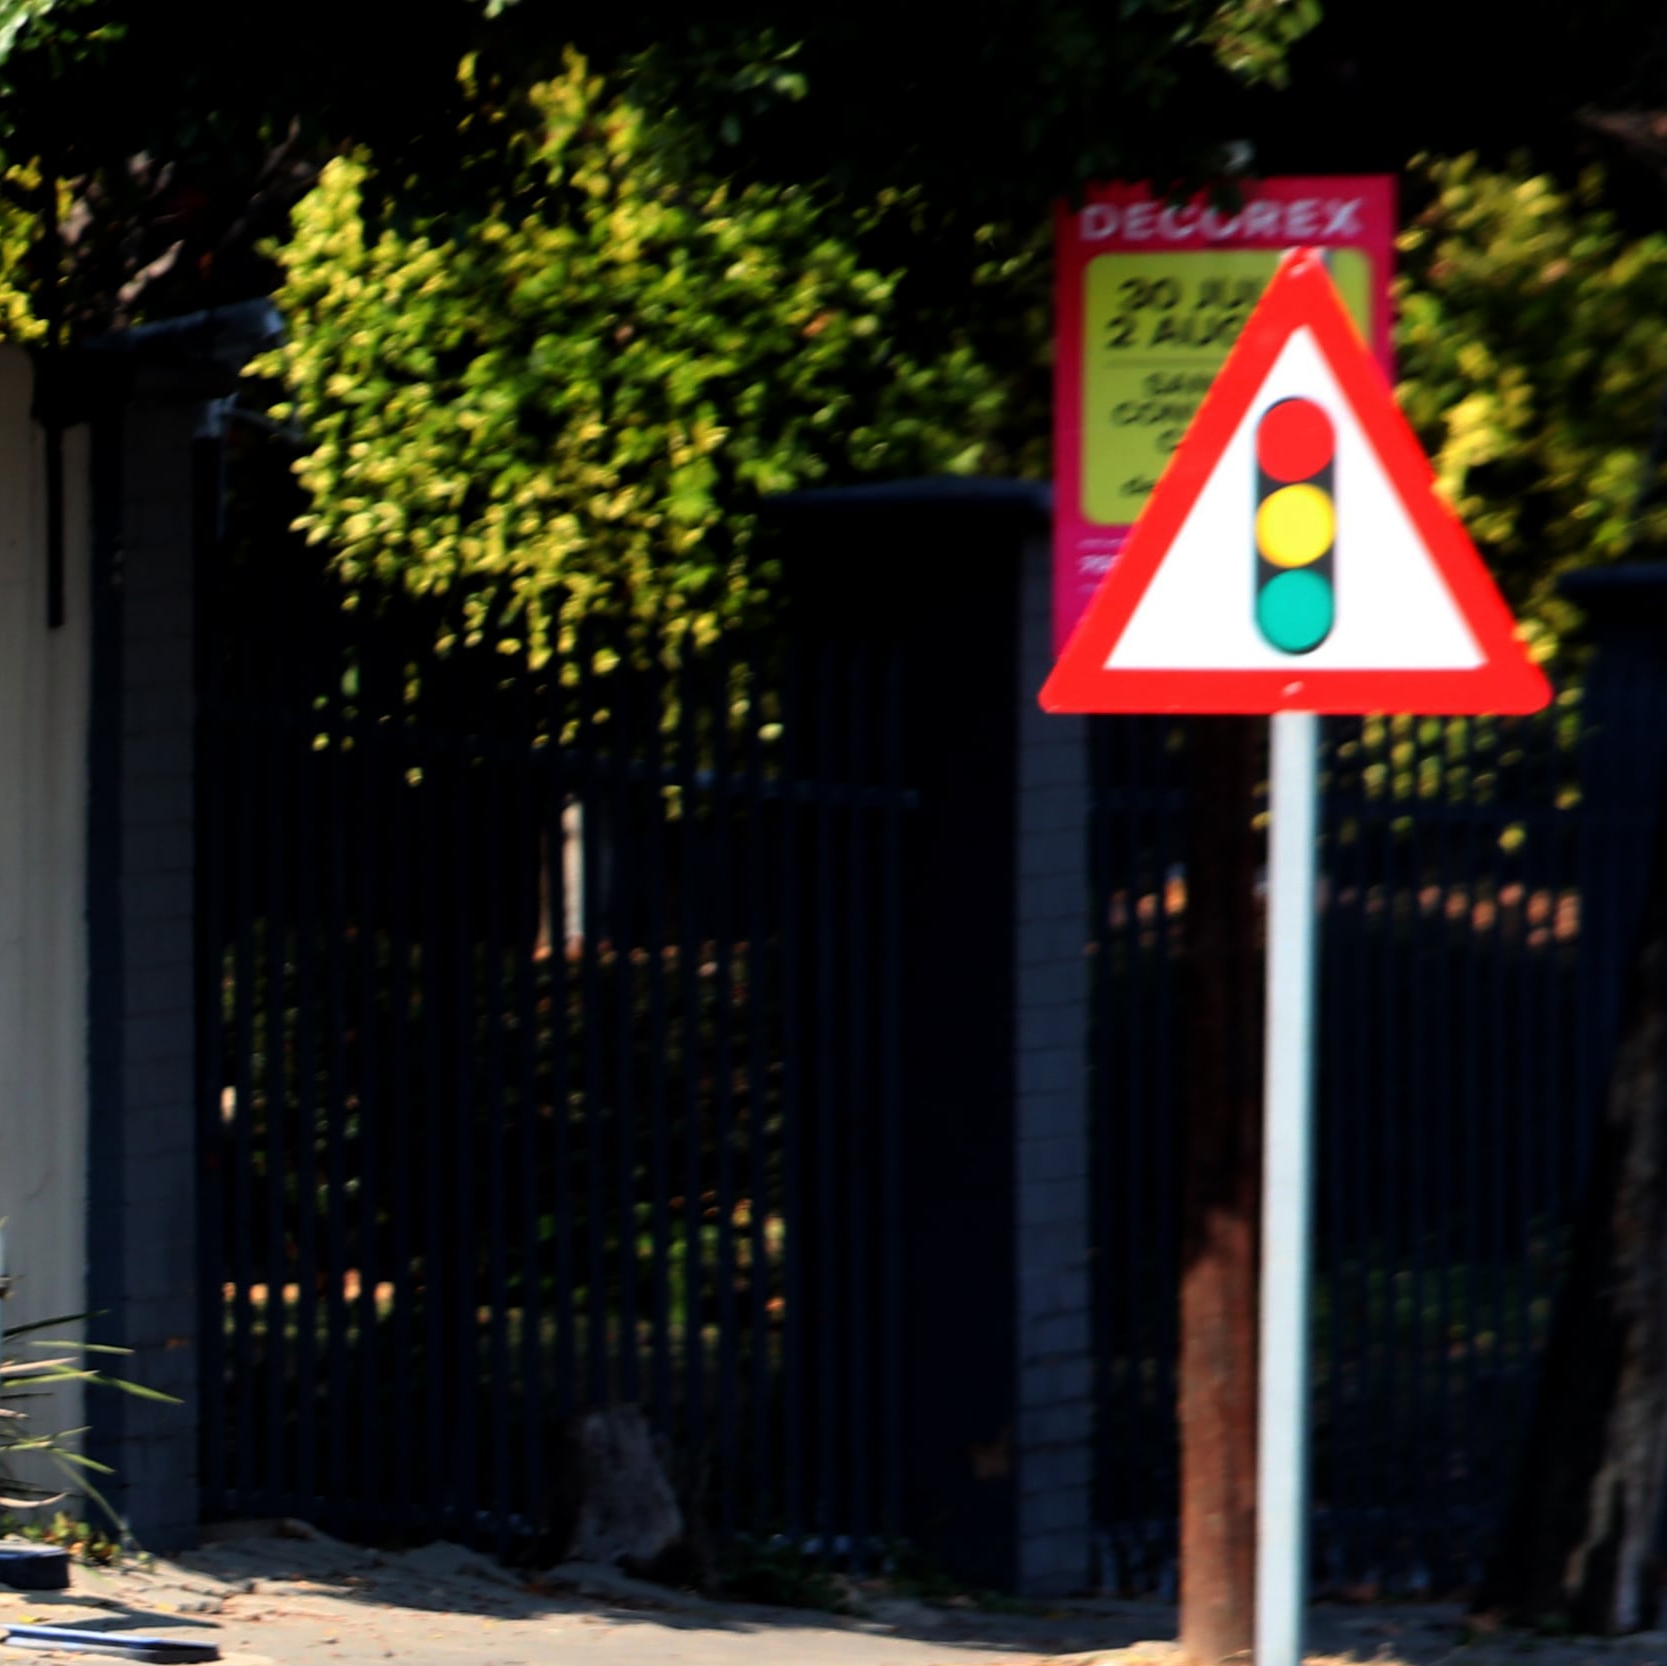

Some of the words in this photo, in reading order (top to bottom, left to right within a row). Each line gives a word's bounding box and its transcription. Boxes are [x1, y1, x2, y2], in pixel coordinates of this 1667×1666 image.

[1078, 198, 1365, 241] DECOREX
[1117, 276, 1181, 311] 30
[1105, 313, 1136, 349] 2
